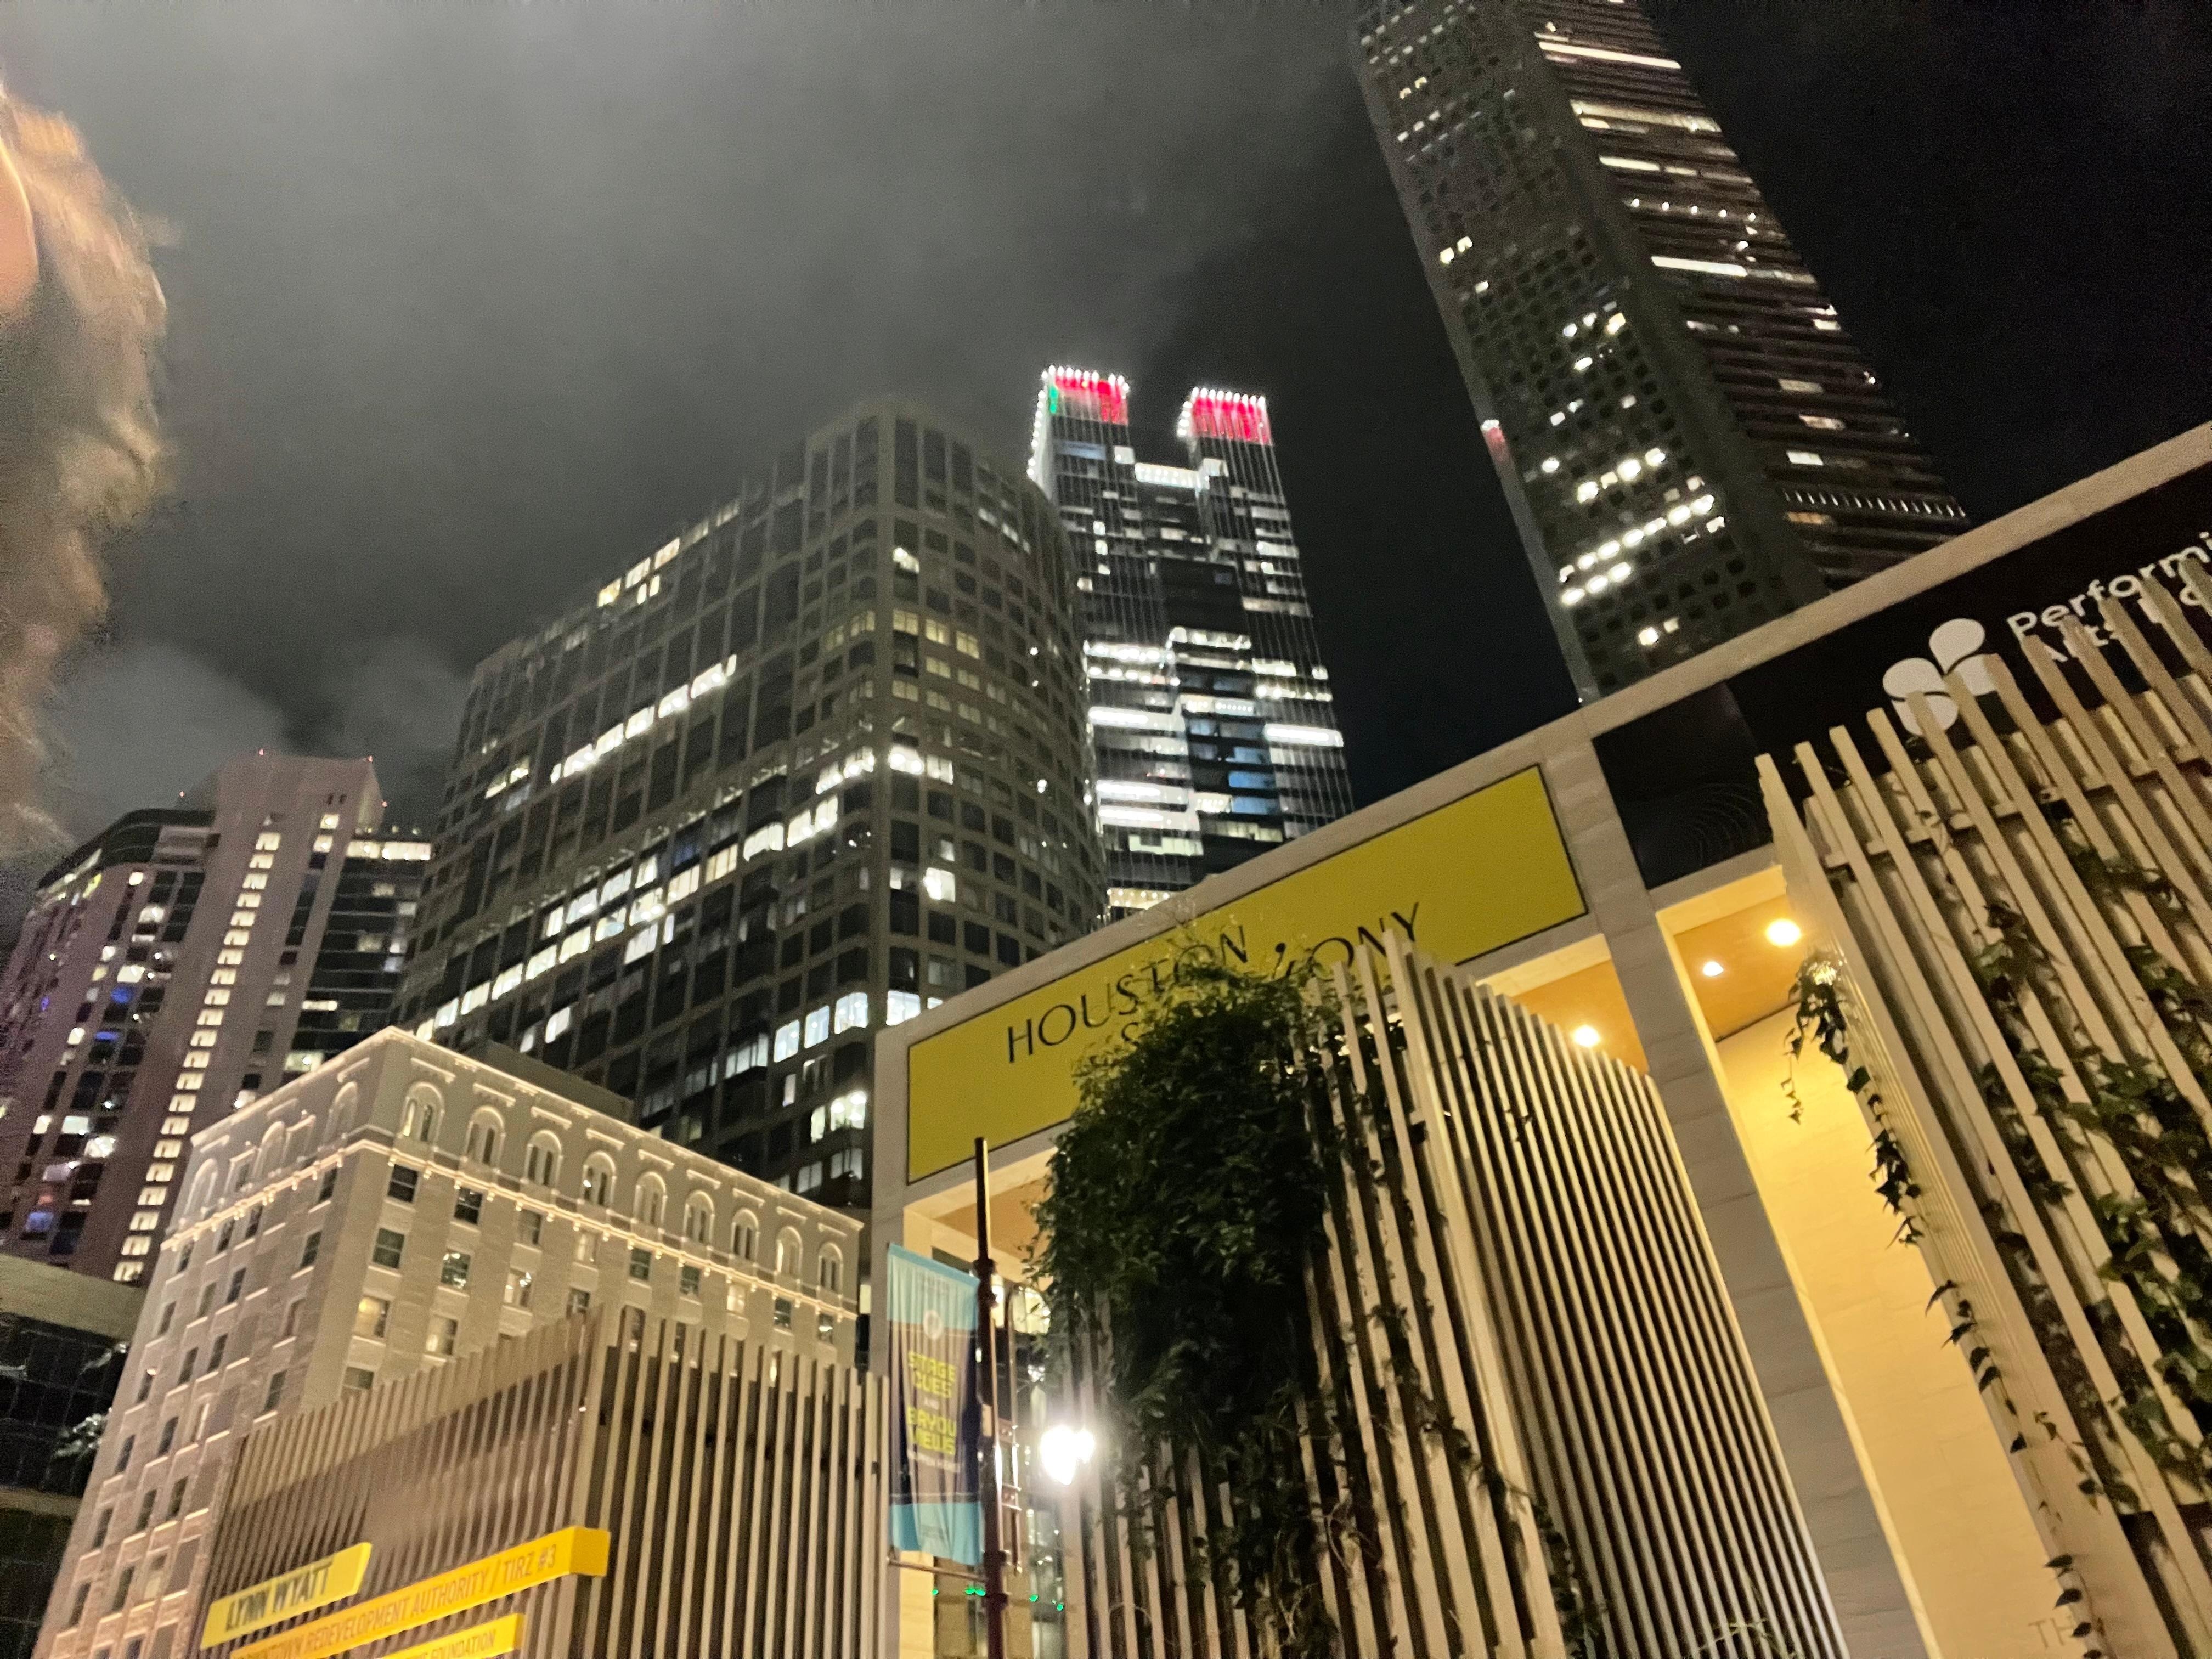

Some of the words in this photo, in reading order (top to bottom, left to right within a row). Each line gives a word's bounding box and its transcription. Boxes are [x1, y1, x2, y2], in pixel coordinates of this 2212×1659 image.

[225, 1585, 272, 1632] LYNN
[273, 1556, 335, 1613] WYATT
[304, 1598, 410, 1652] REDEVELOPMENT
[410, 1568, 488, 1617] AUTHORITY
[503, 1551, 535, 1584] TIRZ
[538, 1543, 557, 1572] #3
